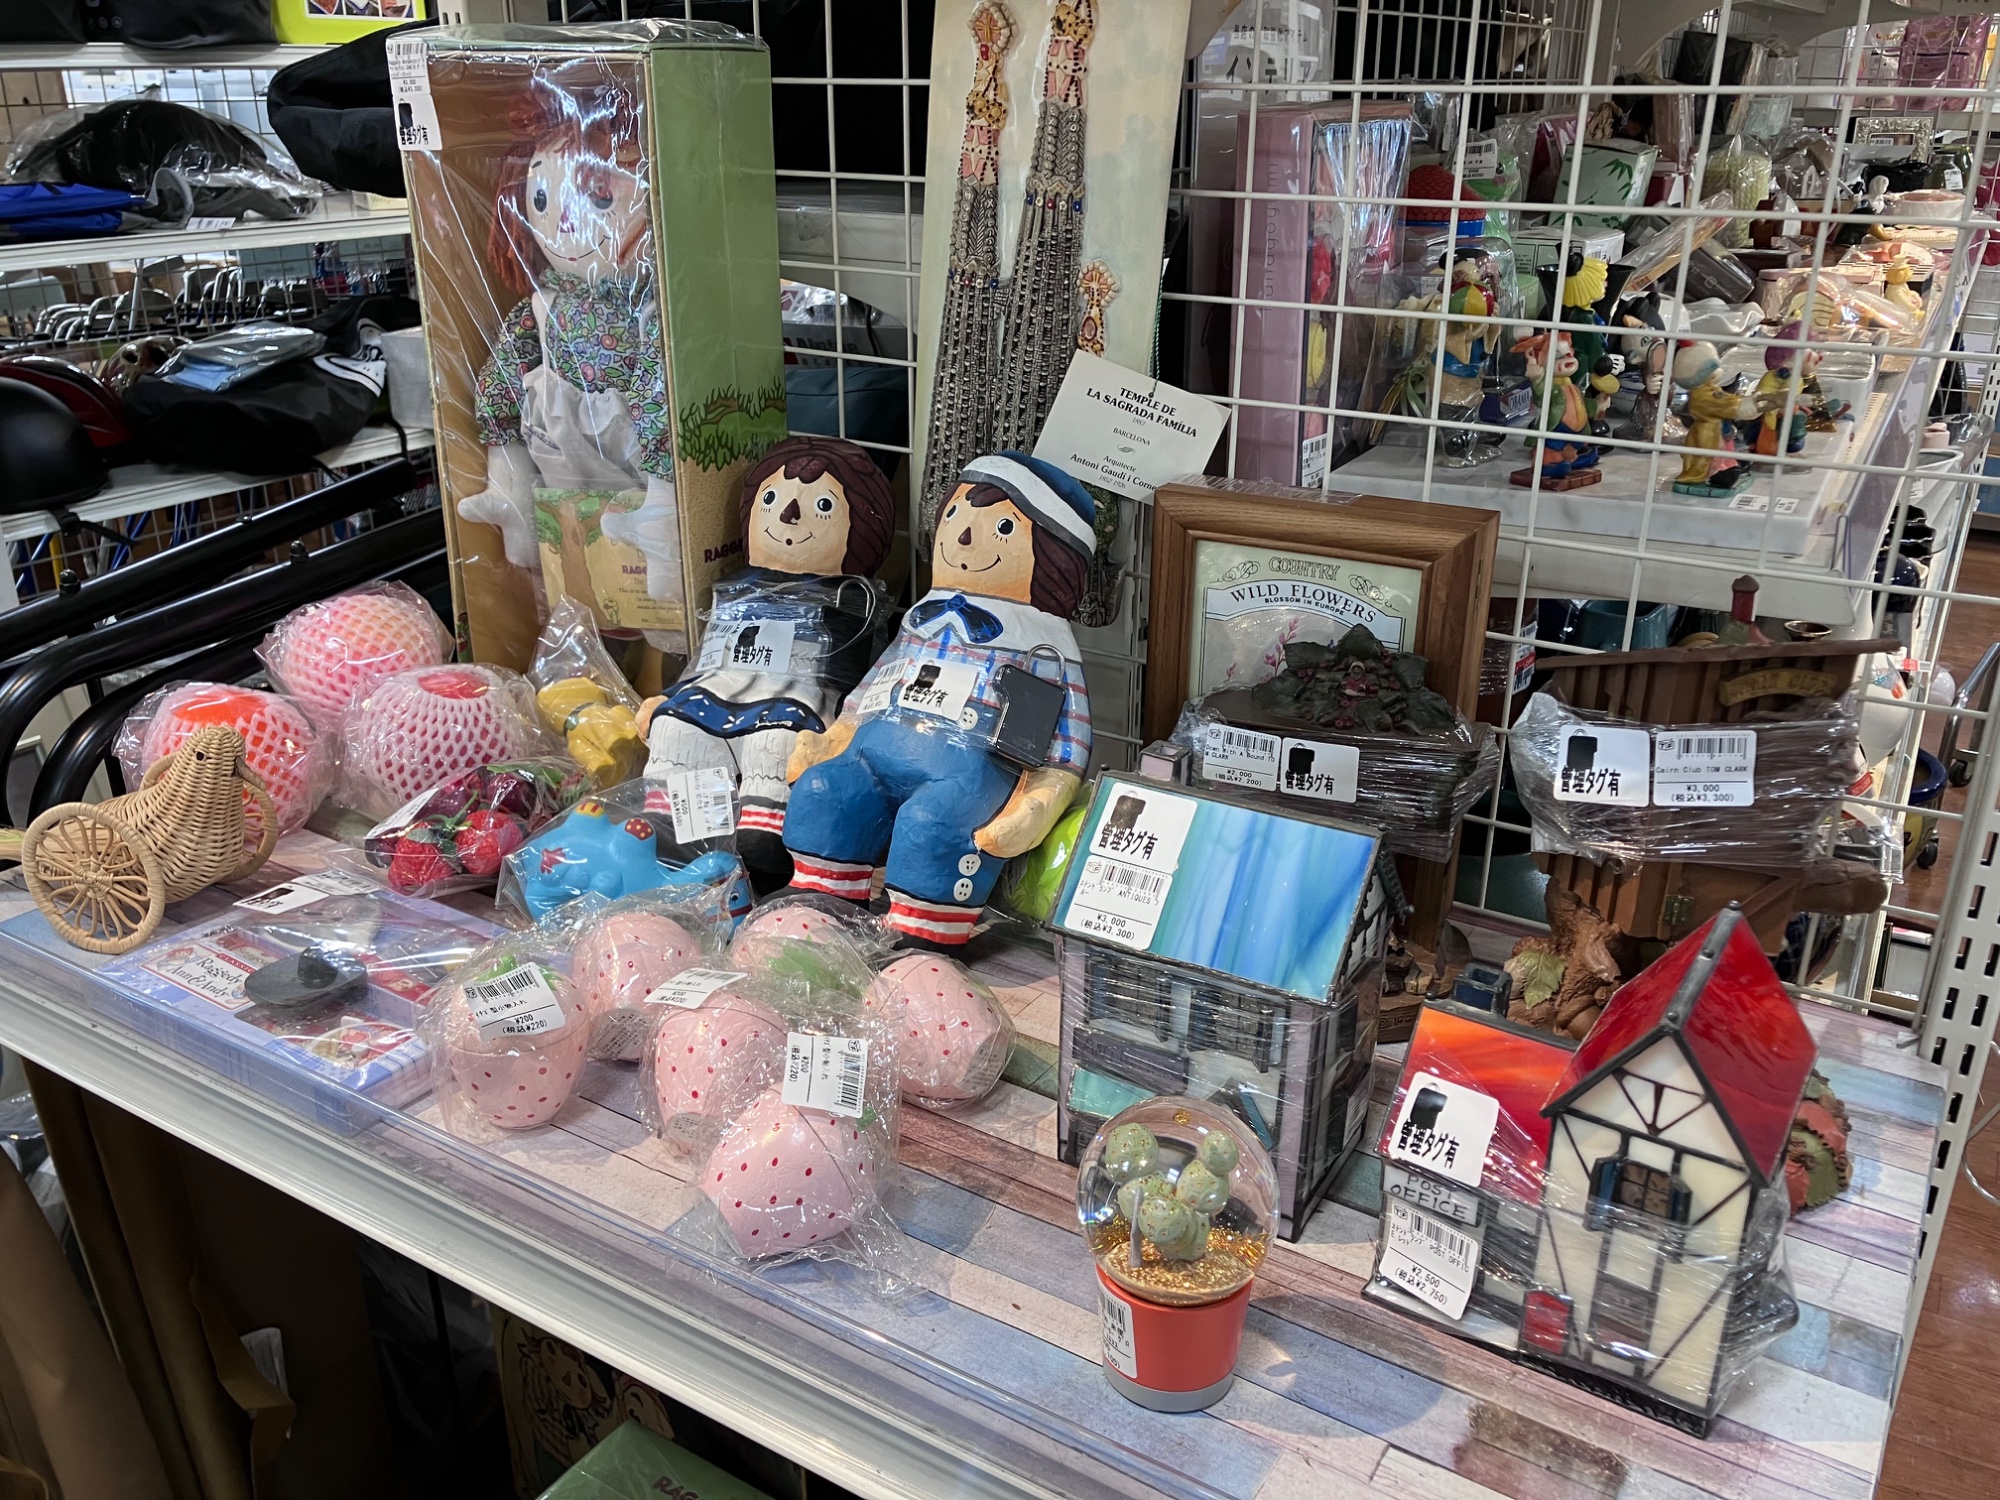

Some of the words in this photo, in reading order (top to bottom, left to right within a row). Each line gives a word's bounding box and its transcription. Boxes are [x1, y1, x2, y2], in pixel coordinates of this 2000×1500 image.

[1086, 387, 1101, 401] LA
[1102, 395, 1154, 422] SAGRADA
[1156, 416, 1198, 437] FAMÍLIA
[1120, 387, 1161, 410] TEMPLE
[1162, 404, 1177, 417] DE
[1112, 427, 1151, 446] BARCELONA
[1070, 453, 1099, 470] Antoni
[1101, 465, 1127, 480] Gaudí
[1268, 556, 1341, 581] COUNTRY
[1230, 583, 1280, 603] WILD
[1290, 584, 1377, 623] FLOWERS
[1264, 596, 1302, 604] BLOSSOM
[1315, 602, 1345, 616] EUROPE
[1285, 770, 1335, 795] 管理タグ有
[1561, 765, 1621, 797] 管理タグ有
[1098, 821, 1158, 861] 管理タグ有
[1118, 890, 1152, 905] ANTIQUES
[197, 957, 244, 985] Raggedy
[502, 1019, 548, 1034] (税込¥220)
[514, 1013, 534, 1025] ¥200
[1398, 1118, 1460, 1169] 管理タグ有
[1390, 1183, 1471, 1220] OFFICE
[1411, 1264, 1441, 1288] ¥2,500
